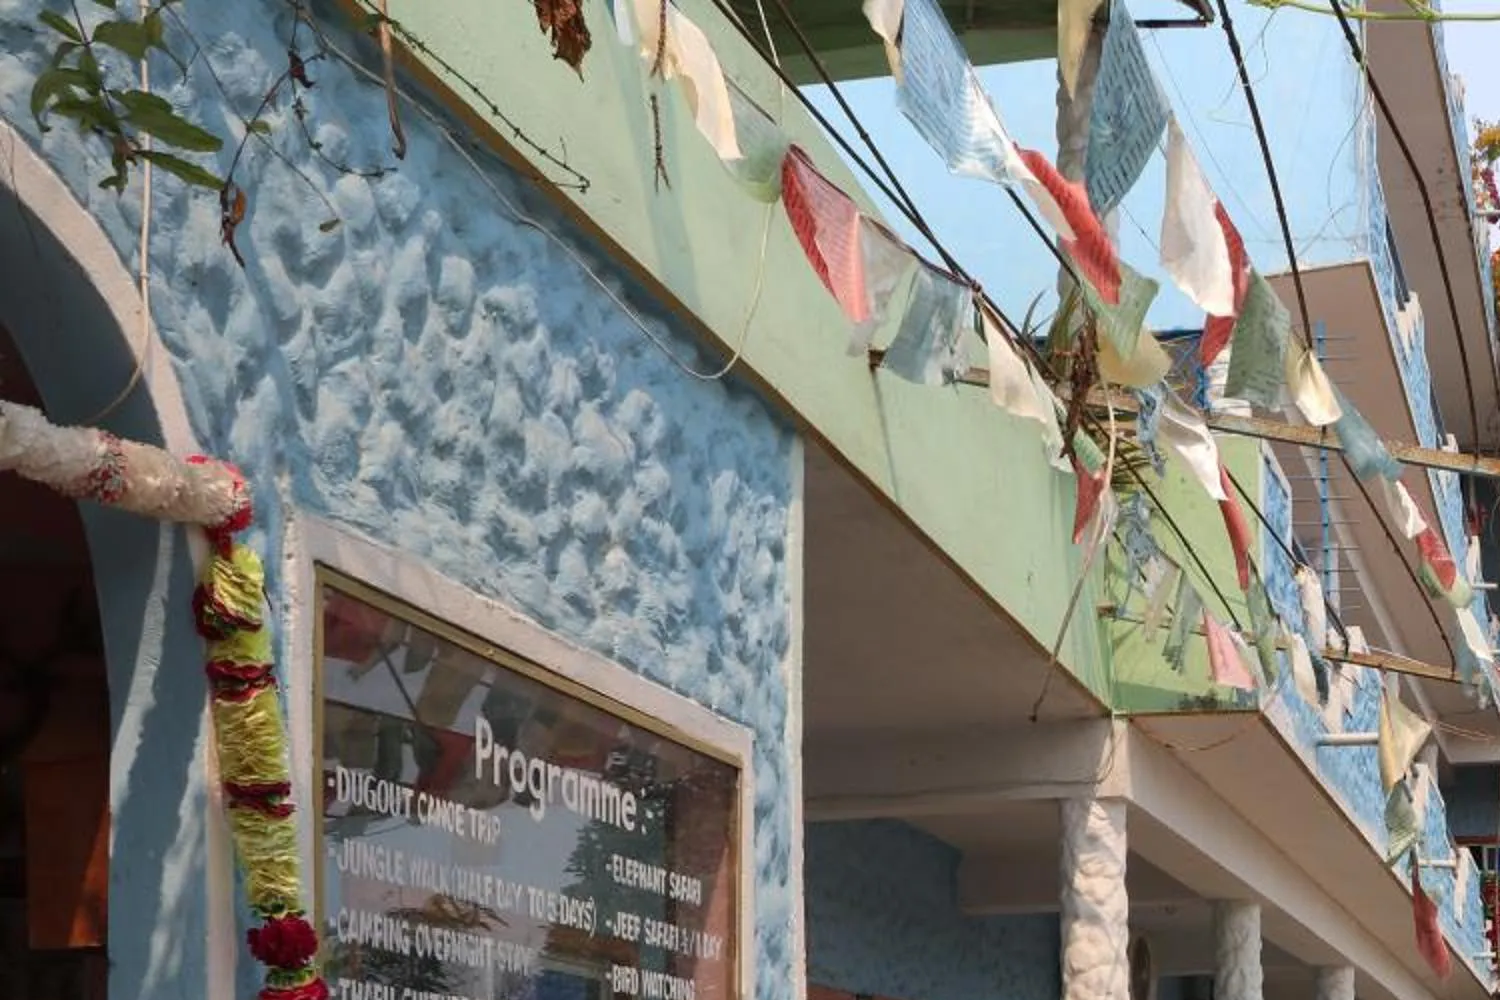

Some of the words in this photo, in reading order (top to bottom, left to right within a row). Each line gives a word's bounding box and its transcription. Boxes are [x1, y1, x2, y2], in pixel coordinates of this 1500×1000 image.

[336, 764, 414, 819] DUGOUT
[417, 791, 465, 836] CANOE
[336, 837, 404, 886] JUNGLE
